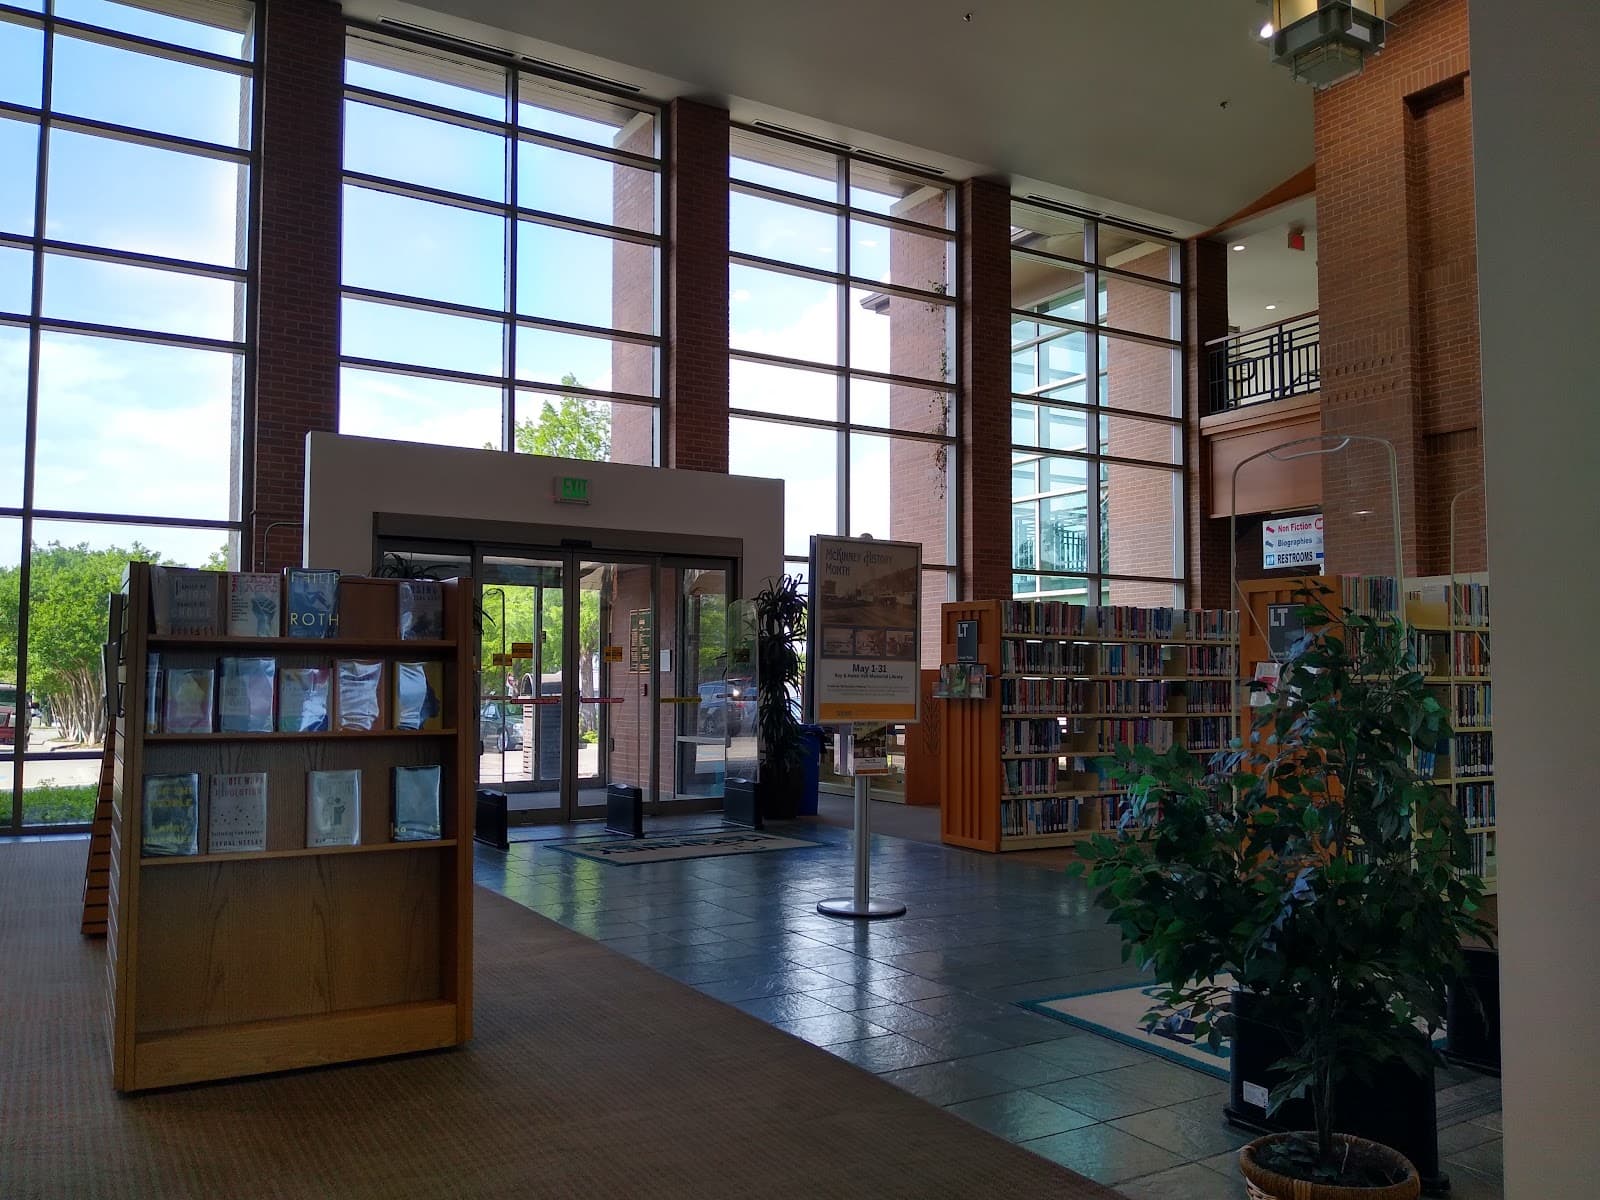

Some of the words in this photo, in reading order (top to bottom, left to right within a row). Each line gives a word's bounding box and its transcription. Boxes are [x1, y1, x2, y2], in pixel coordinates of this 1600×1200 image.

[563, 478, 588, 497] EXIT
[1278, 524, 1289, 533] Non
[1290, 522, 1312, 531] Fiction
[1277, 537, 1313, 547] Biographies
[1277, 552, 1313, 564] RESTROOMS
[290, 612, 339, 626] ROTH
[1270, 608, 1288, 627] LT
[957, 624, 968, 638] LT
[852, 664, 870, 673] May
[871, 664, 887, 673] 1-31
